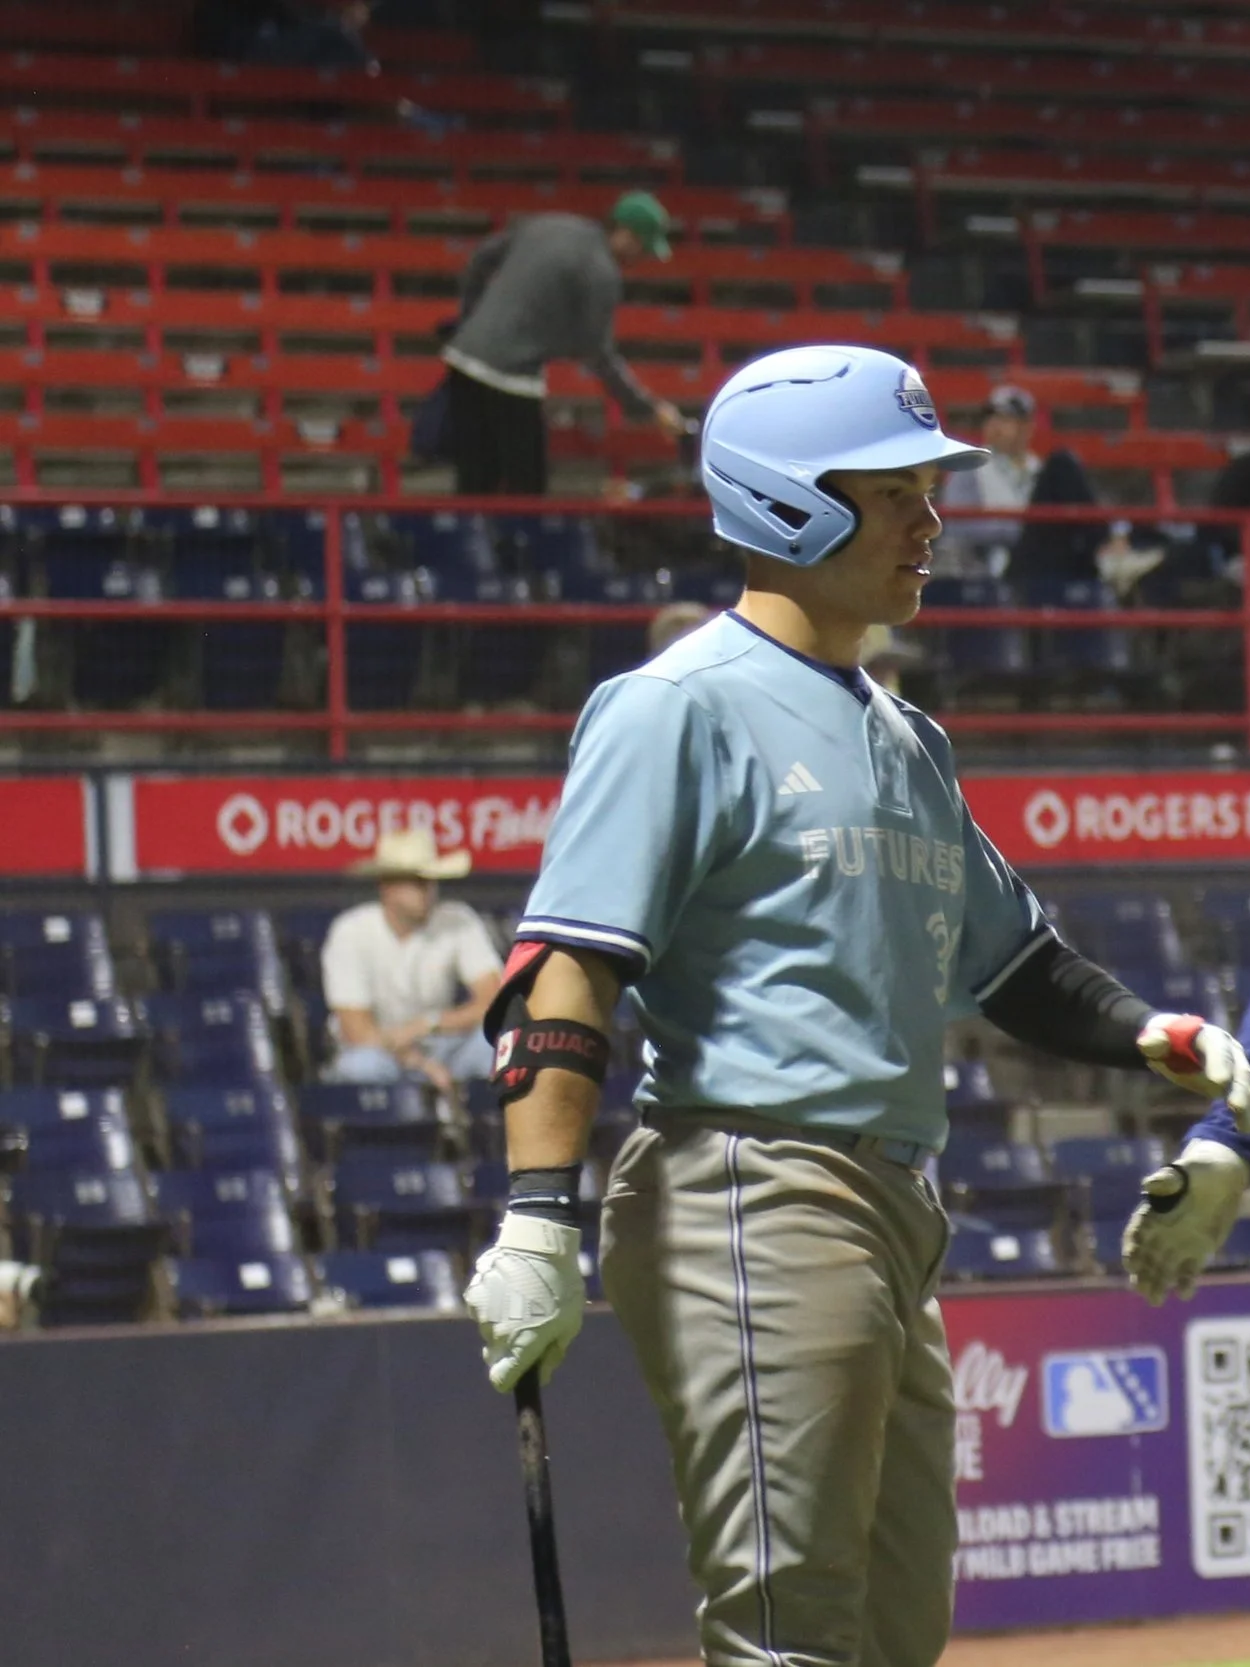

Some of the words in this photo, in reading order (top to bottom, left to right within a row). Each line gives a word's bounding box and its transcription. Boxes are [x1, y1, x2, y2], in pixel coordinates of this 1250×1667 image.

[274, 797, 464, 849] ROGERS
[1074, 792, 1240, 842] ROGERS
[798, 826, 965, 894] FUTURES
[1055, 1495, 1160, 1537] STREAM
[1027, 1539, 1099, 1575] GAME
